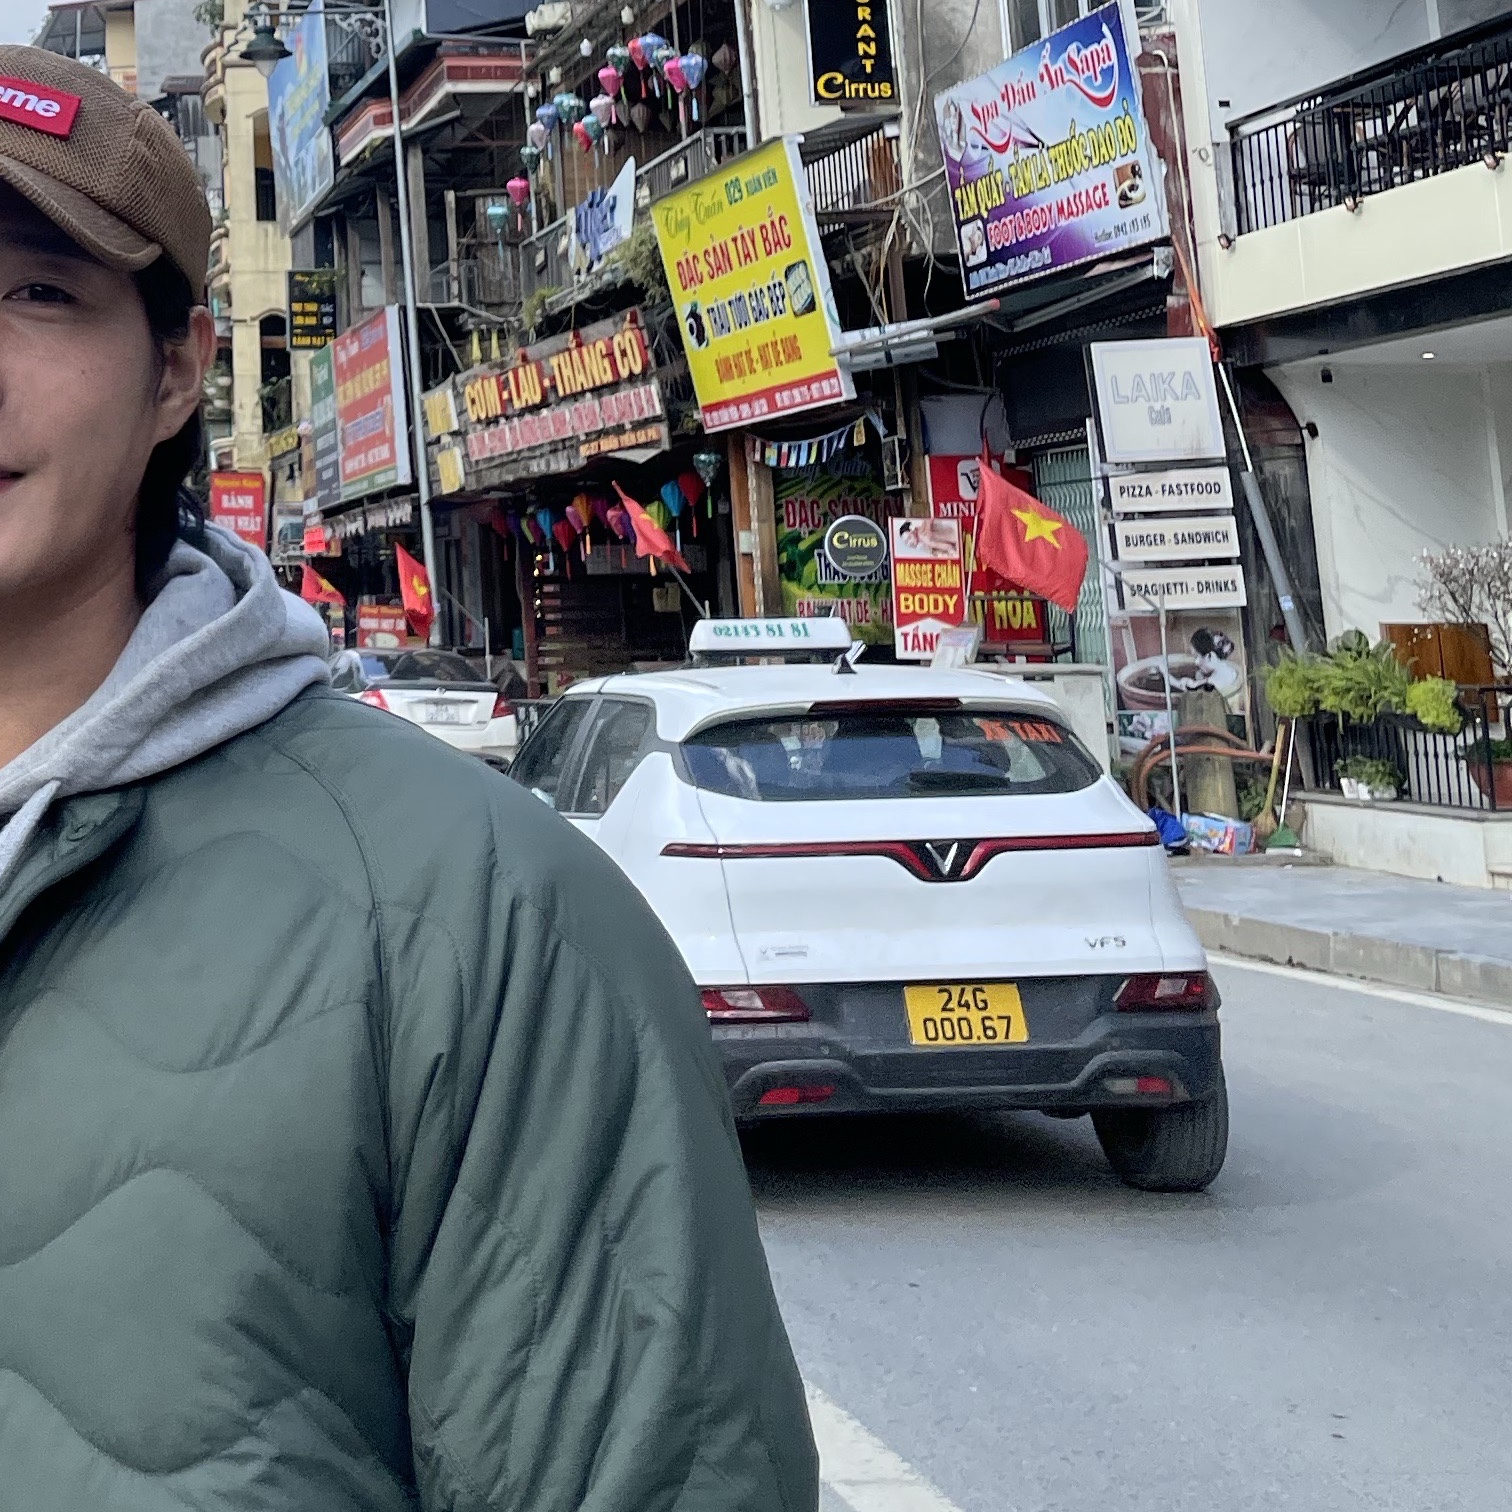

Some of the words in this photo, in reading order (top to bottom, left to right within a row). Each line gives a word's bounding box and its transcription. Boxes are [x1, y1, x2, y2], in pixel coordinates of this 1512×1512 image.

[817, 71, 892, 99] Cirrus
[1088, 119, 1117, 169] DAO
[1056, 182, 1111, 222] MASSAGE
[1110, 370, 1202, 405] LAIKA
[1119, 484, 1153, 500] PIZZA
[1161, 482, 1222, 498] FASTFOOD
[939, 500, 977, 518] MINI
[832, 531, 878, 549] Cirrus
[1125, 533, 1167, 548] BURGER
[1173, 530, 1230, 546] SANDWICH
[1197, 578, 1238, 595] DRINKS
[900, 593, 959, 615] BODY
[766, 623, 786, 637] 81
[791, 621, 811, 637] 81
[939, 986, 990, 1013] 24G
[922, 1013, 1013, 1043] 000.67
